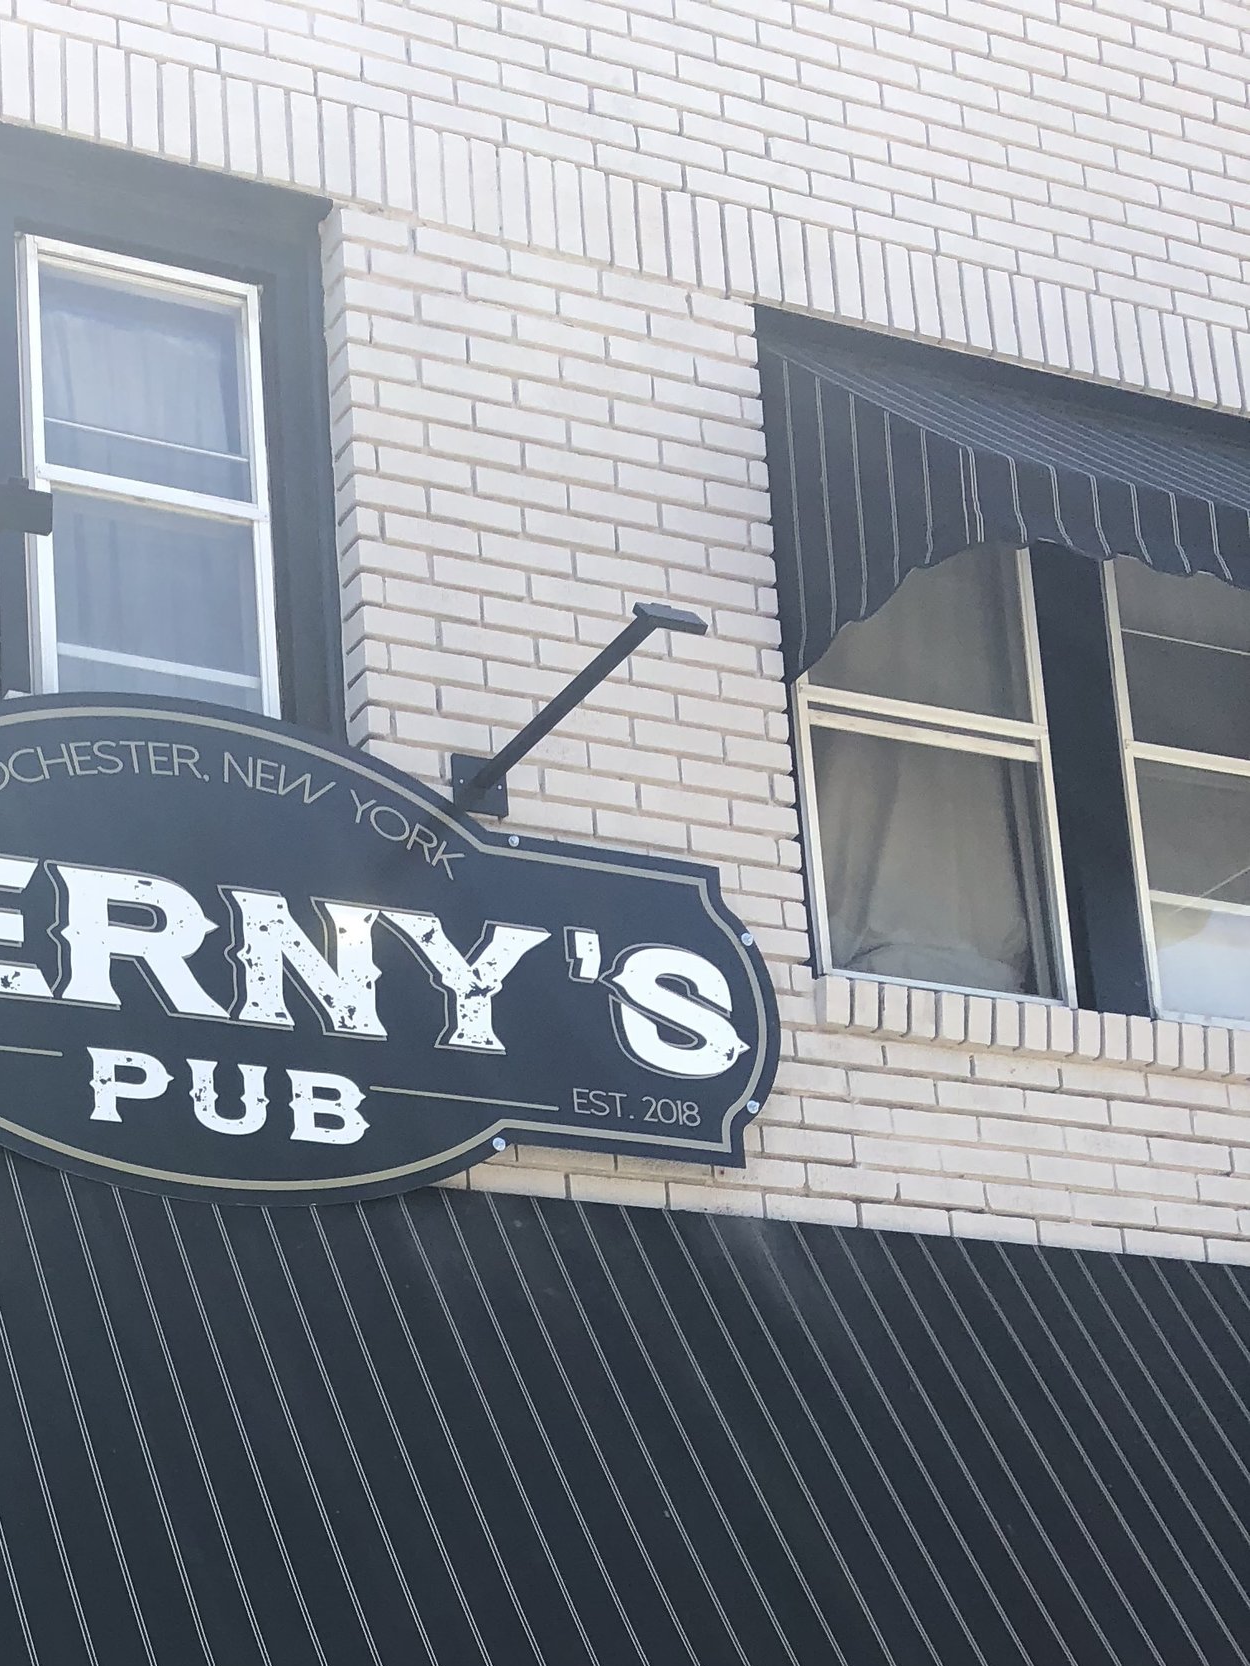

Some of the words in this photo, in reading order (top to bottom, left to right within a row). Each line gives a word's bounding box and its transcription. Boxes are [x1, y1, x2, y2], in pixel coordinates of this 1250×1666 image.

[223, 751, 336, 804] NEW
[350, 789, 464, 881] YORK
[86, 1046, 371, 1147] PUB
[572, 1087, 634, 1119] EST.
[641, 1096, 701, 1127] 2018
